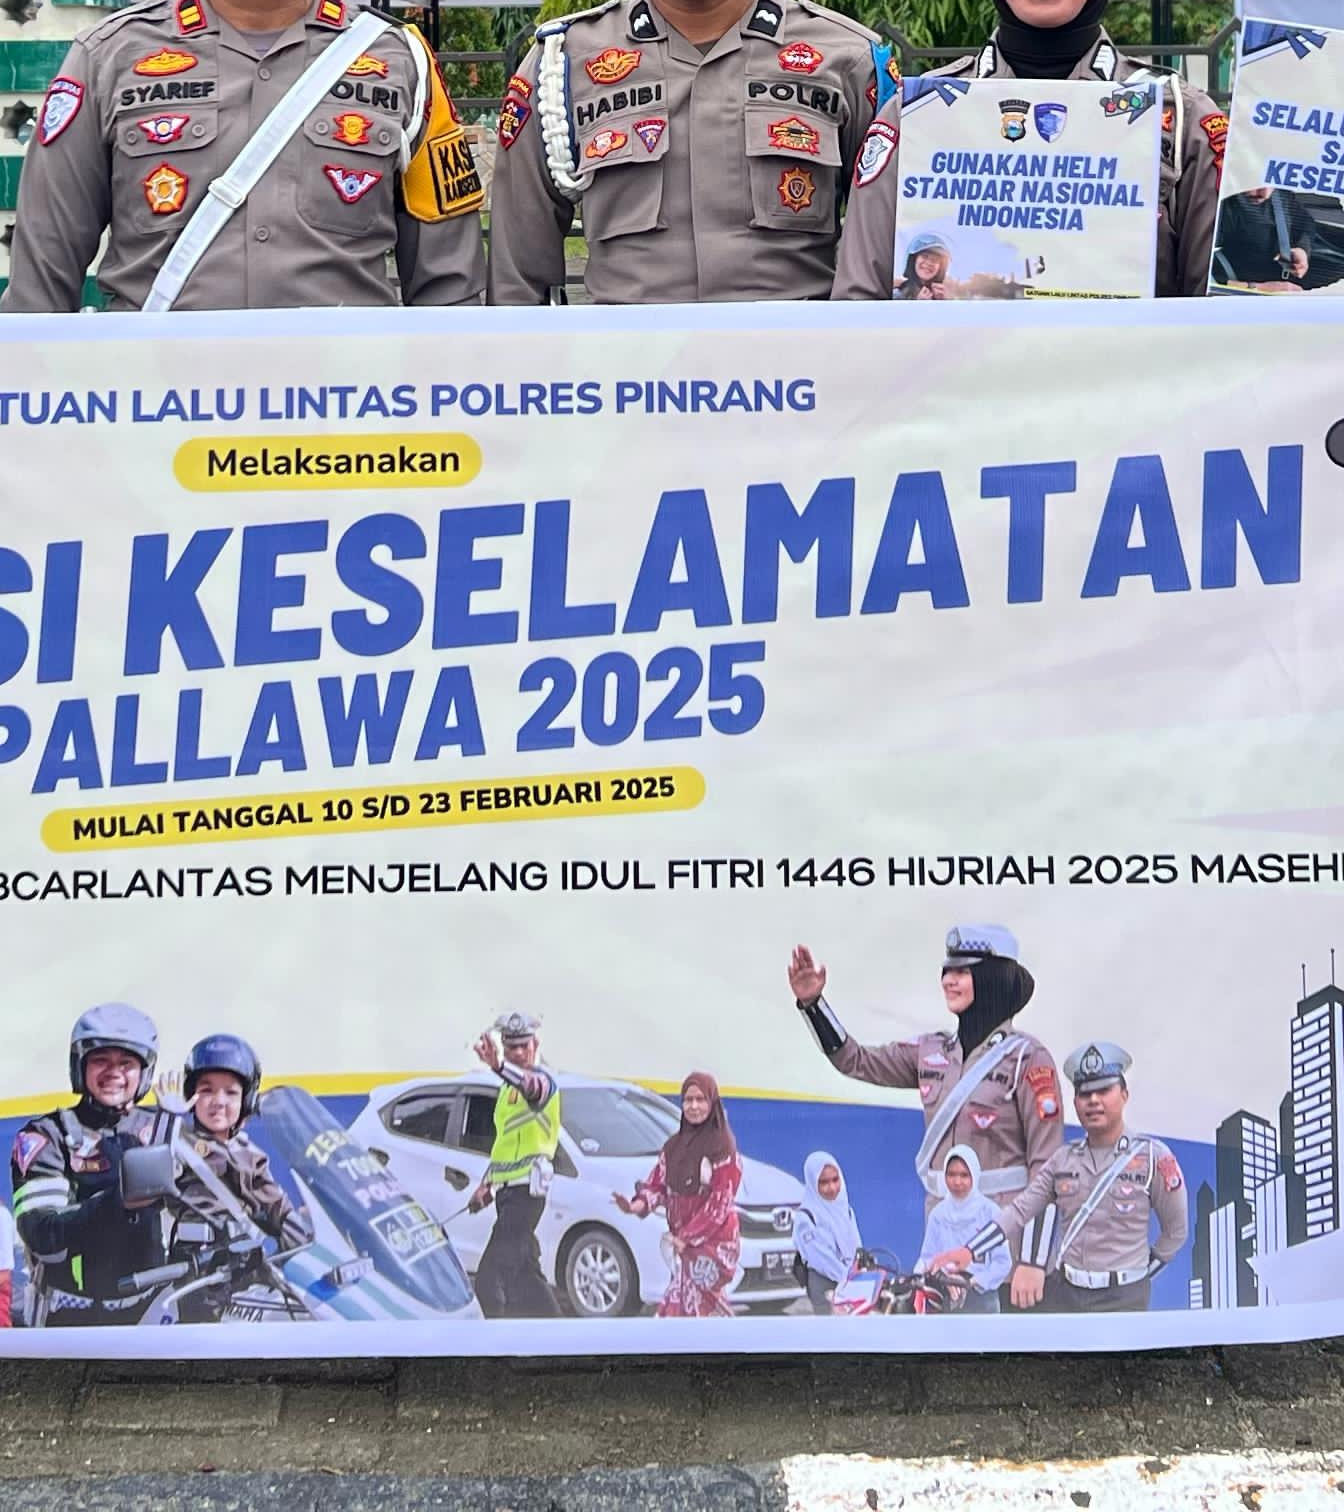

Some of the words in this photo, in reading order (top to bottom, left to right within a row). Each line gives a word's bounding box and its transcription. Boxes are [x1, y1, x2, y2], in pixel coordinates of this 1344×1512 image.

[120, 81, 216, 106] SYARIEF
[330, 82, 398, 111] OLRI
[576, 84, 662, 126] HABIBI
[748, 82, 841, 116] POLRI
[931, 151, 1047, 178] GUNAKAN
[1052, 155, 1118, 180] HELM
[903, 175, 1014, 203] STANDAR
[1020, 179, 1145, 208] NASIONAL
[957, 203, 1084, 231] INDONESIA
[131, 388, 245, 423] LALU
[259, 384, 418, 420] LINTAS
[431, 381, 603, 417] POLRES
[615, 379, 817, 414] PINRANG
[207, 445, 460, 477] Melaksanakan
[123, 445, 1303, 676] KESELAMATAN
[516, 640, 766, 752] 2025
[72, 816, 165, 841] MULAI
[173, 803, 313, 834] TANGGAL
[321, 800, 353, 822] 10
[361, 794, 411, 820] S/D
[419, 792, 451, 815] 23
[459, 782, 602, 813] FEBRUARI
[610, 776, 676, 800] 2025
[285, 862, 548, 896] MENJELANG
[560, 859, 656, 891] IDUL
[667, 858, 763, 889] FITRI
[776, 857, 875, 887] 1446
[888, 856, 1055, 886] HIJRIAH
[1067, 854, 1178, 884] 2025
